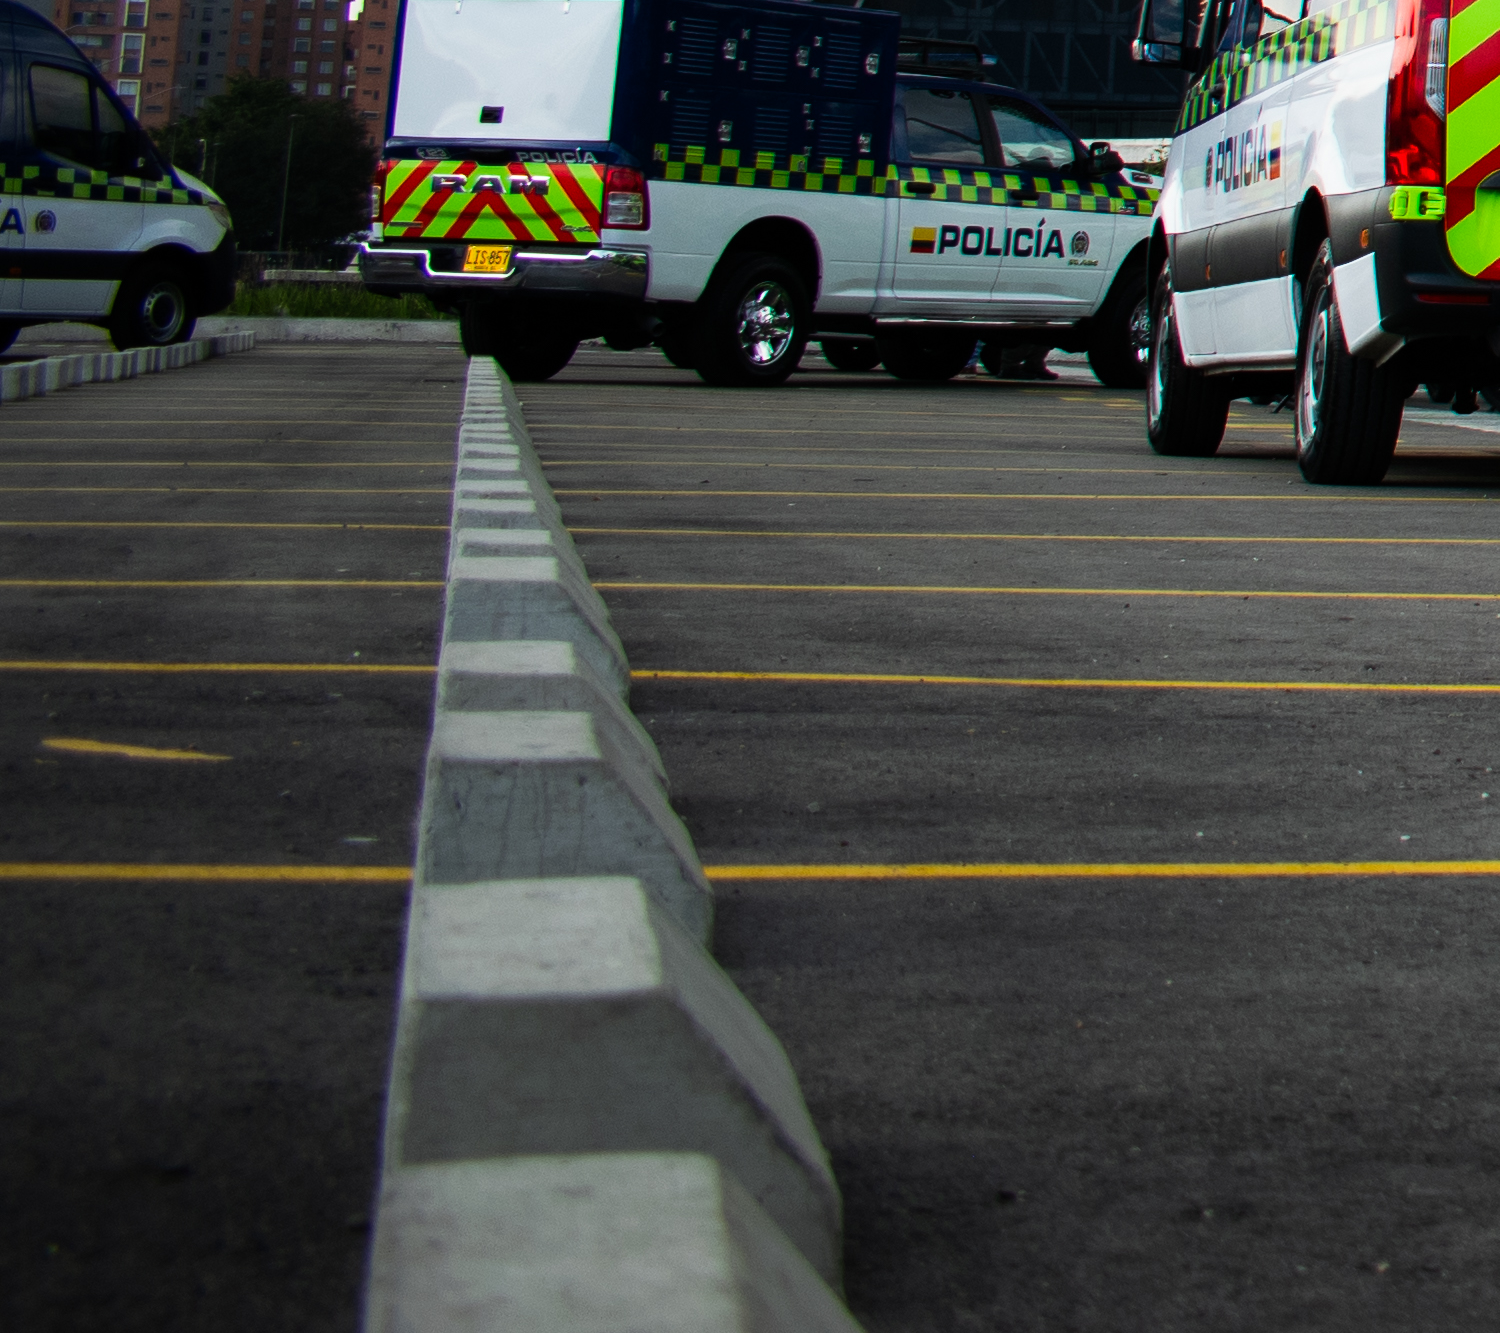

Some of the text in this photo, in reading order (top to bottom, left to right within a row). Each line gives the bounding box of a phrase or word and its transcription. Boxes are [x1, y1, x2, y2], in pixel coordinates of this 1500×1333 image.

[516, 147, 598, 164] POLICÍA
[1215, 102, 1268, 195] POLICÍA
[431, 173, 551, 195] RAM
[937, 217, 1065, 258] POLICÍA
